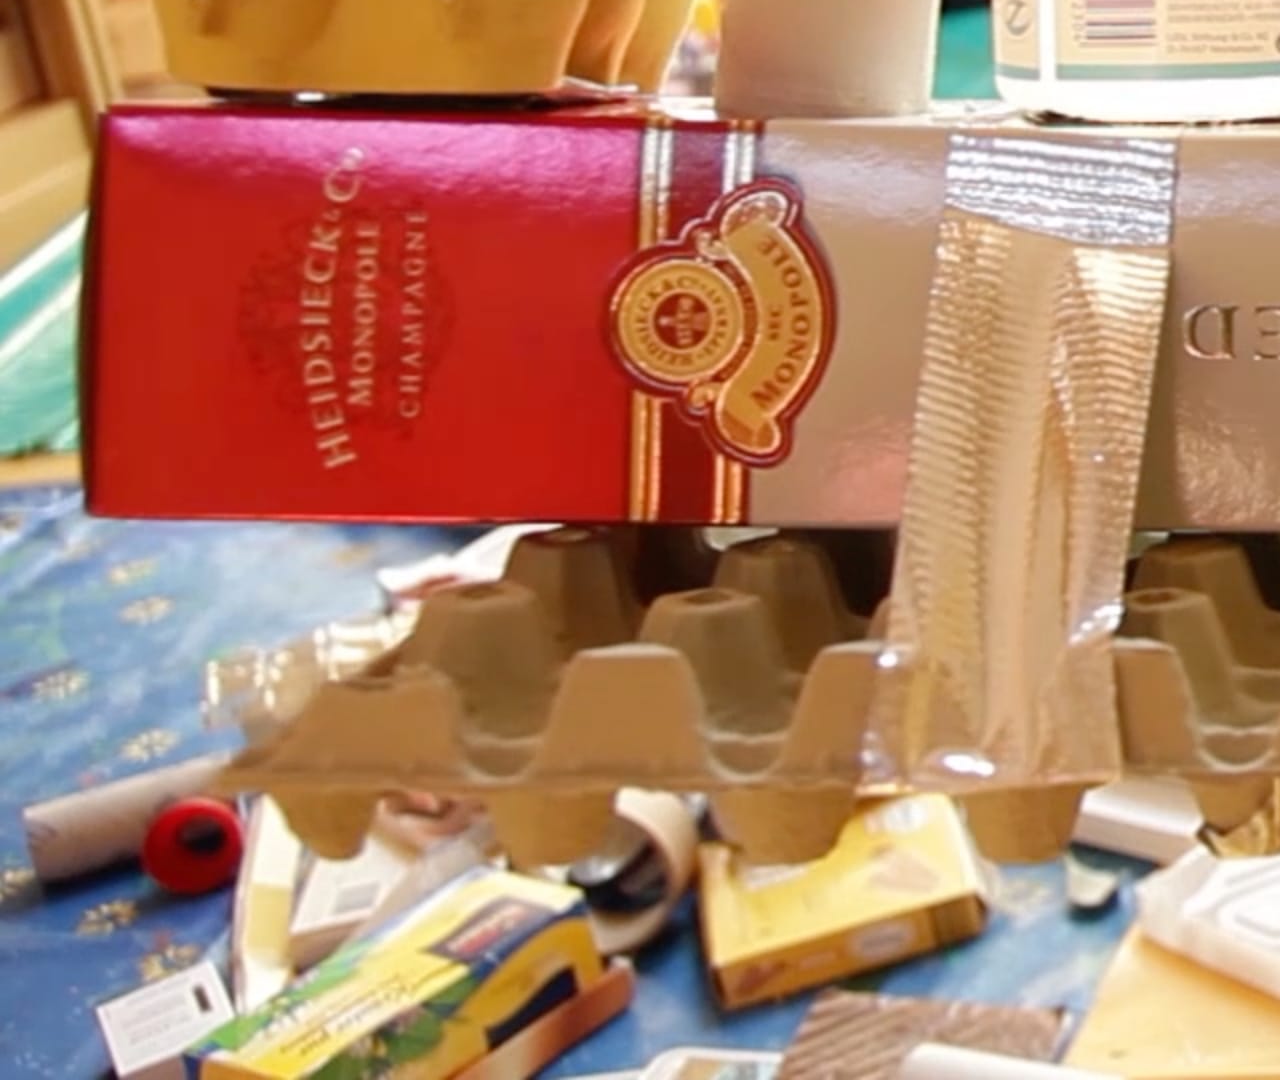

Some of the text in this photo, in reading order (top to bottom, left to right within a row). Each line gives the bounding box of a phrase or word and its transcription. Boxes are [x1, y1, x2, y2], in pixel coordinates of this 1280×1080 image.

[301, 222, 358, 470] HEIDSIECK
[346, 223, 381, 408] MONOPOLE
[400, 210, 428, 419] CHAMPAGNE
[749, 234, 811, 409] MONOPOLE
[763, 303, 781, 343] SEC
